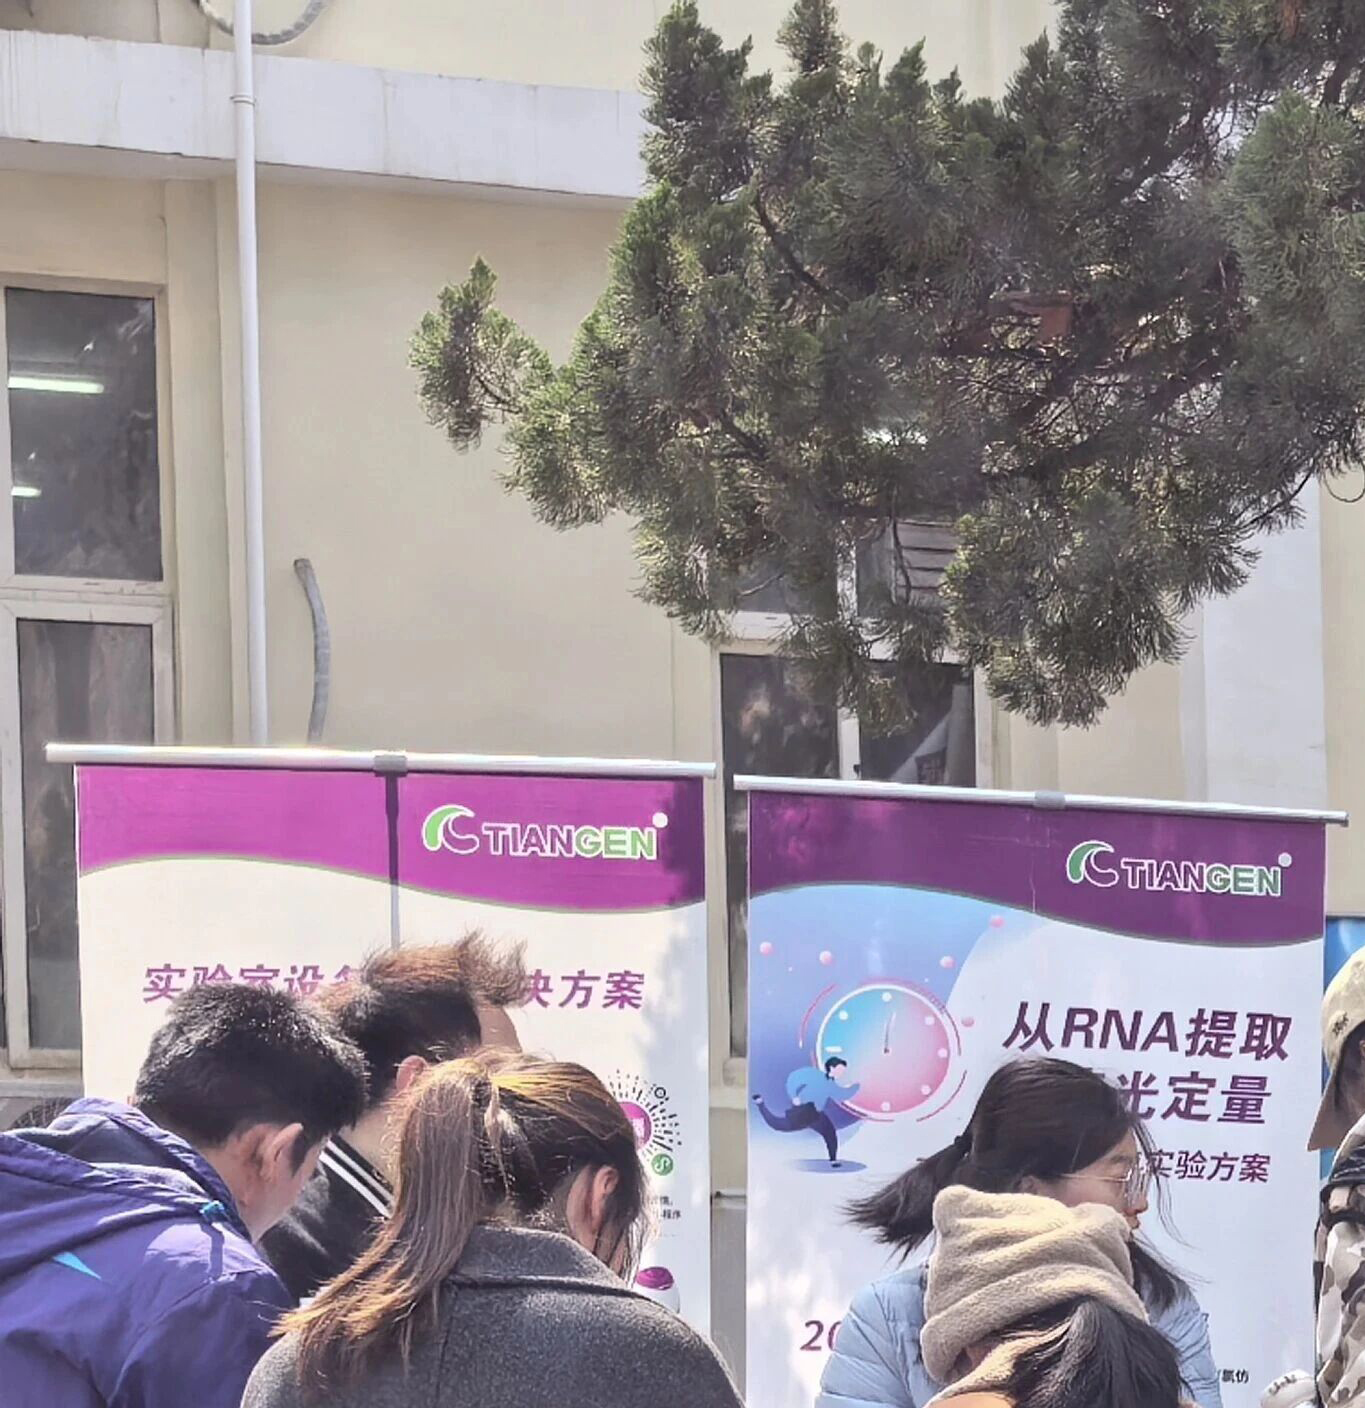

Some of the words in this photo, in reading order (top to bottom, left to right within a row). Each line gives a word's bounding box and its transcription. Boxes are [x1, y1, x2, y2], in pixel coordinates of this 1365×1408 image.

[482, 822, 658, 861] TIANGEN
[1120, 857, 1282, 897] TIANGEN
[1001, 1001, 1292, 1061] 从RNA提取
[1112, 1070, 1272, 1125] 光定量
